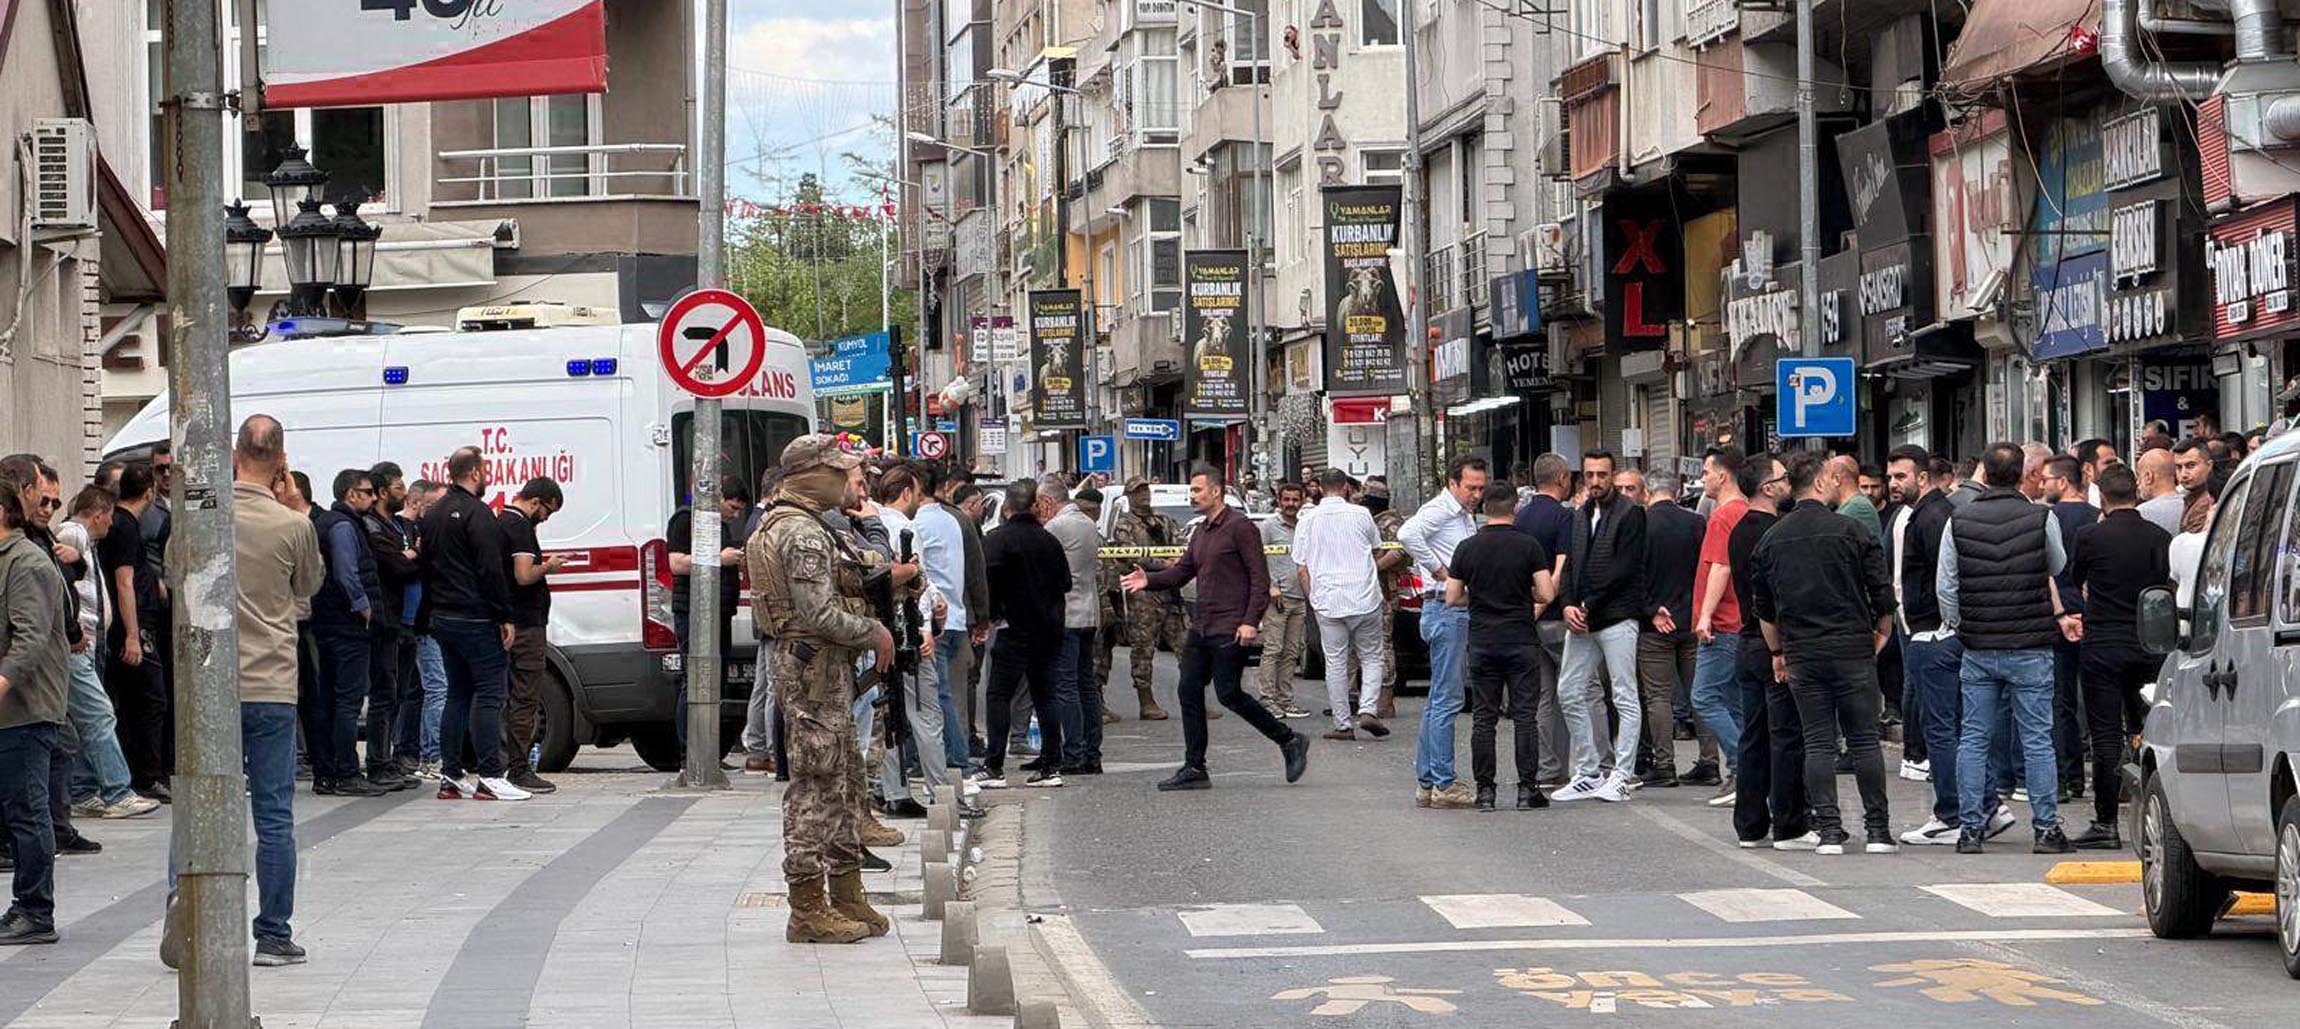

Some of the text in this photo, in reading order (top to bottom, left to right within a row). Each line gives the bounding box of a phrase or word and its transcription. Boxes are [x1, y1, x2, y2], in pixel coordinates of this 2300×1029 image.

[1340, 205, 1391, 215] YAMANLAR
[1191, 282, 1242, 297] KURBANLIK
[1507, 351, 1550, 377] HOTE
[736, 371, 795, 399] LANS
[2177, 397, 2189, 410] &
[482, 427, 513, 454] T.C.
[420, 450, 574, 487] SAĞ BAKANLIĞI
